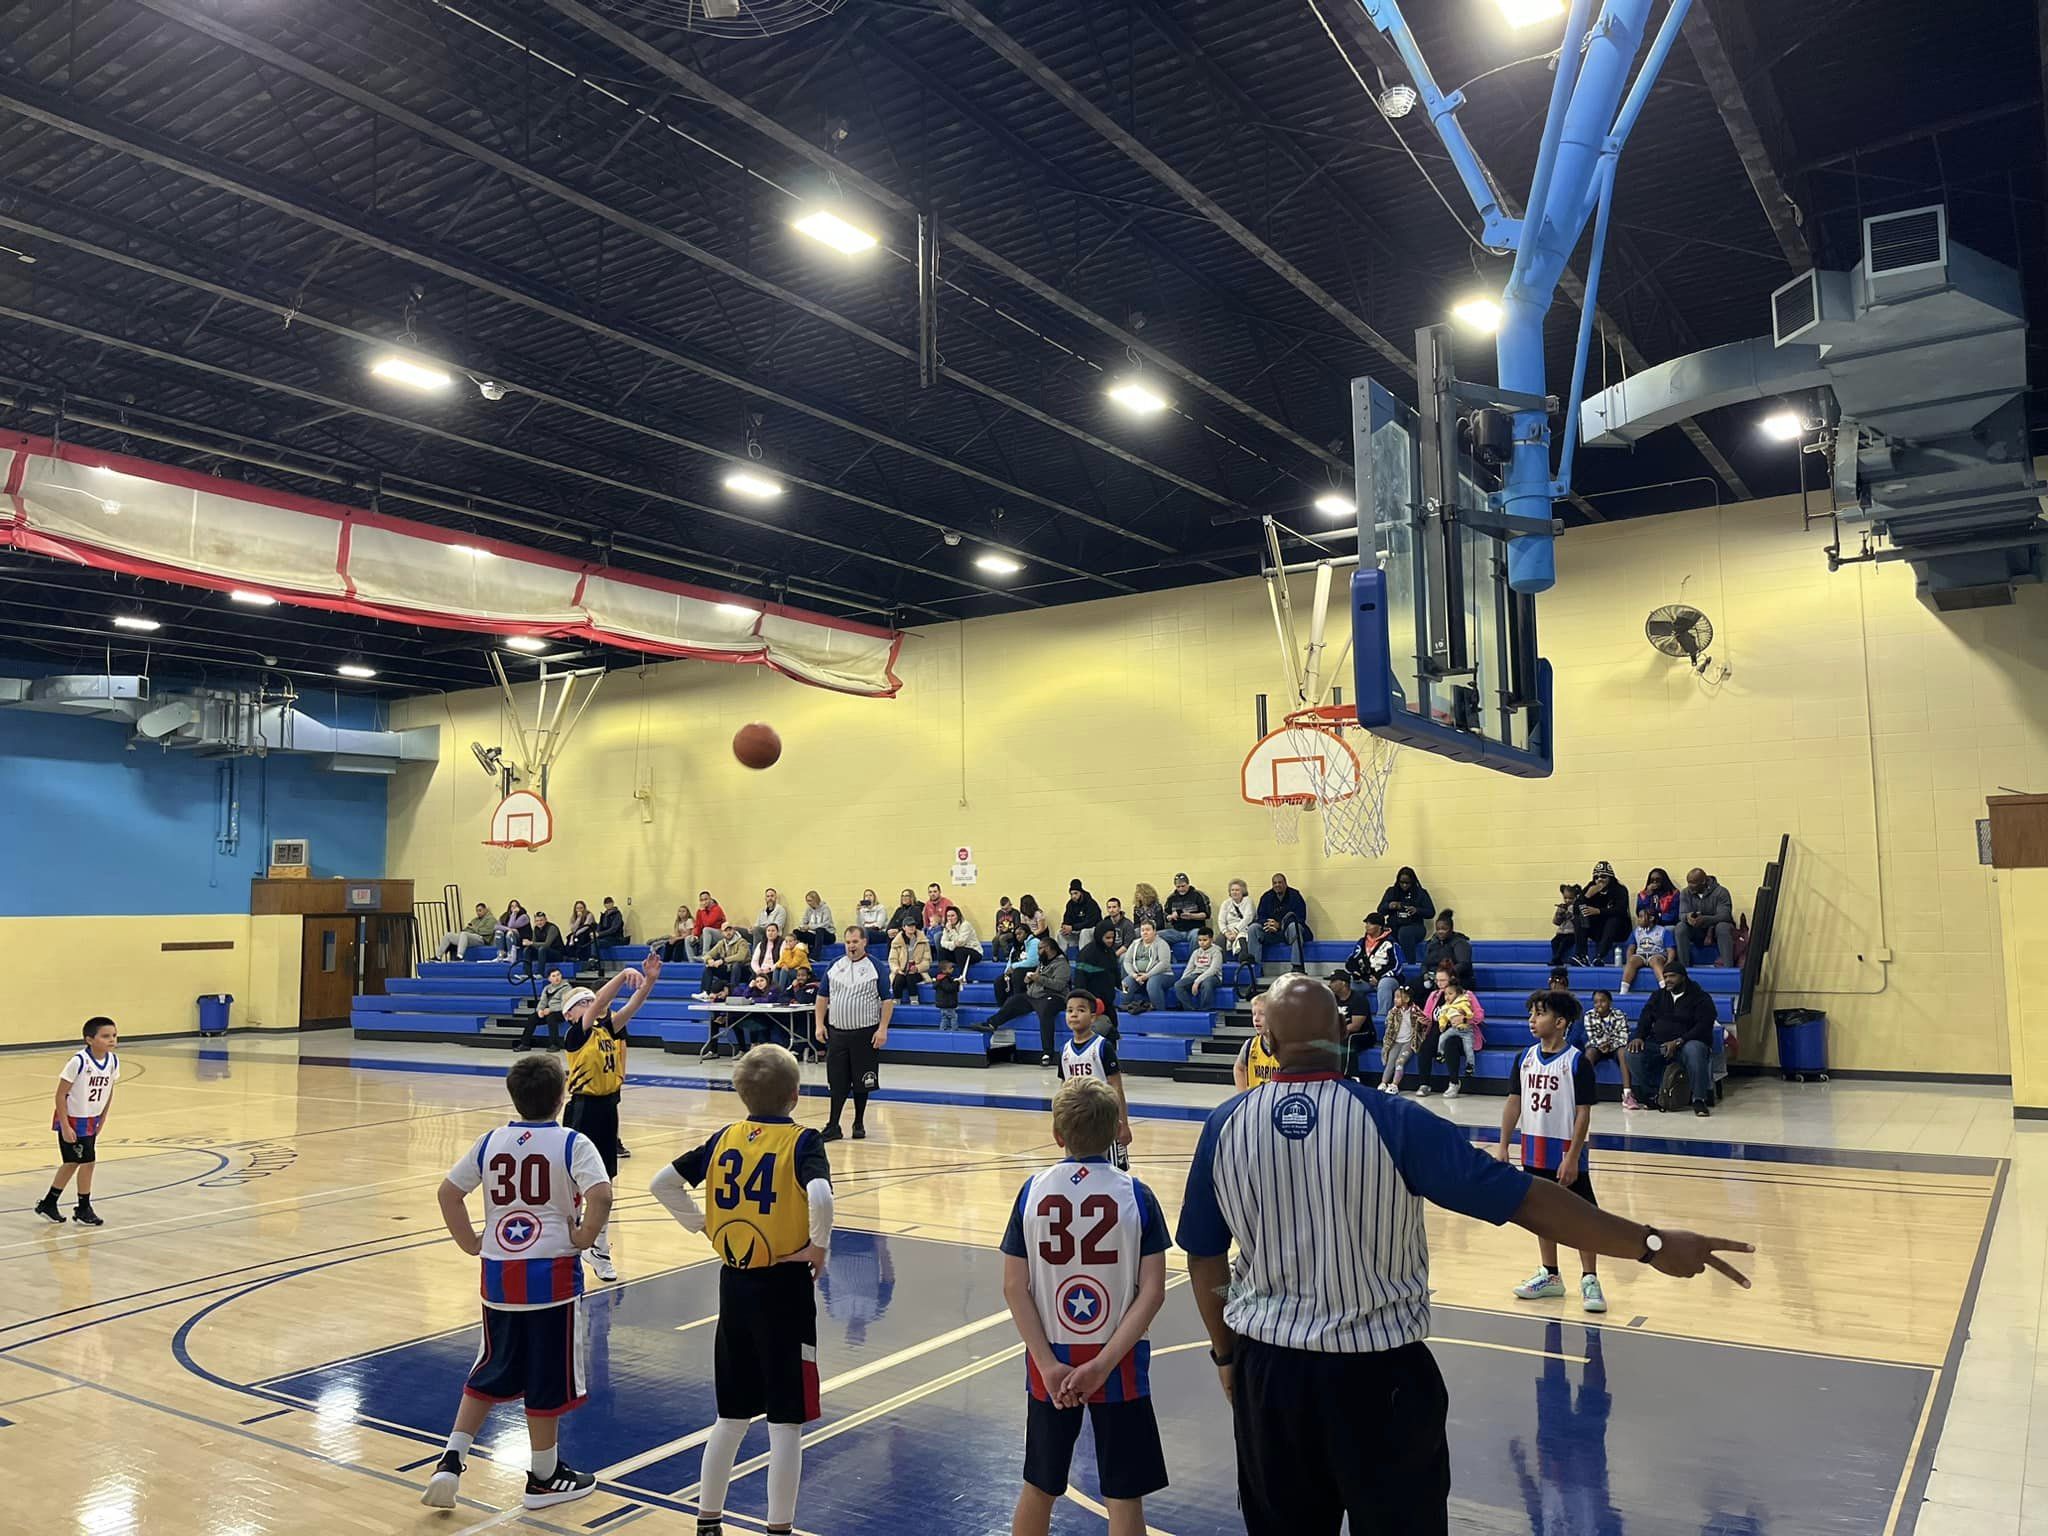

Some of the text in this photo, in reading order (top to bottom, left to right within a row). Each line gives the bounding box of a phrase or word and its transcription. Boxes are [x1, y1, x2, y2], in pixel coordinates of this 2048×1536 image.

[1069, 1063, 1092, 1076] NETS
[89, 1076, 109, 1087] NETS
[1528, 1074, 1559, 1091] NETS
[88, 1089, 102, 1102] 21
[1531, 1092, 1552, 1113] 34
[490, 1153, 550, 1206] 30
[715, 1148, 777, 1215] 34
[1037, 1194, 1118, 1265] 32
